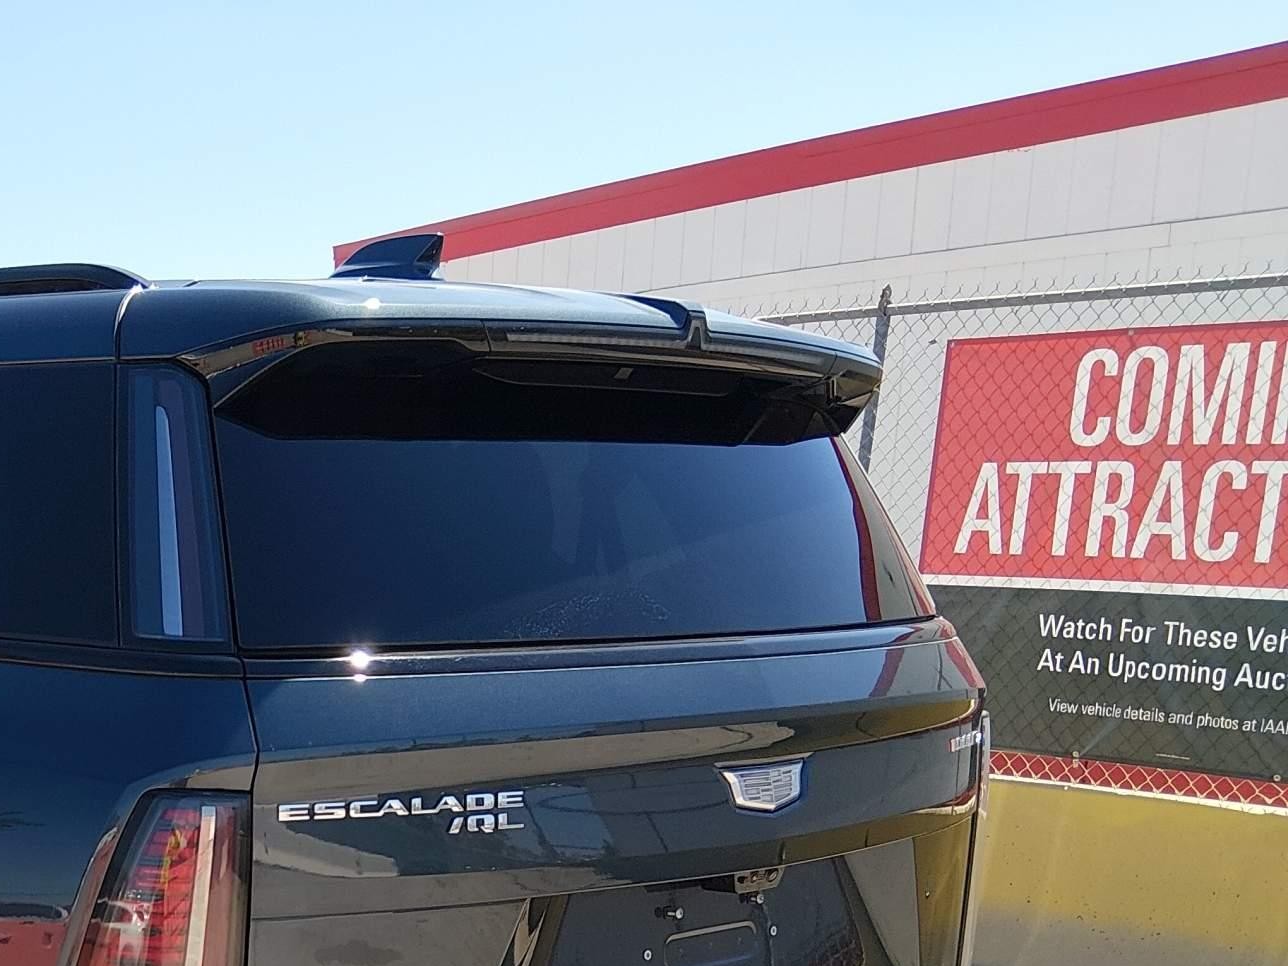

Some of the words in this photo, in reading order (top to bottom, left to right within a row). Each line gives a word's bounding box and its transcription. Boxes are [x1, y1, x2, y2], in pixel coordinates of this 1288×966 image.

[953, 459, 1288, 564] ATTRACT
[1038, 613, 1112, 641] Watch
[1119, 618, 1157, 645] For
[1164, 620, 1238, 650] These
[1037, 648, 1064, 673] At
[1068, 650, 1100, 675] An
[1108, 652, 1228, 692] Upcoming
[1233, 662, 1288, 691] Auc
[1048, 697, 1079, 714] View
[1081, 702, 1122, 718] vehicle
[1123, 705, 1166, 723] details
[1168, 711, 1194, 726] and
[1196, 715, 1239, 731] photos
[1242, 719, 1257, 732] at
[277, 790, 525, 822] ESCALADE
